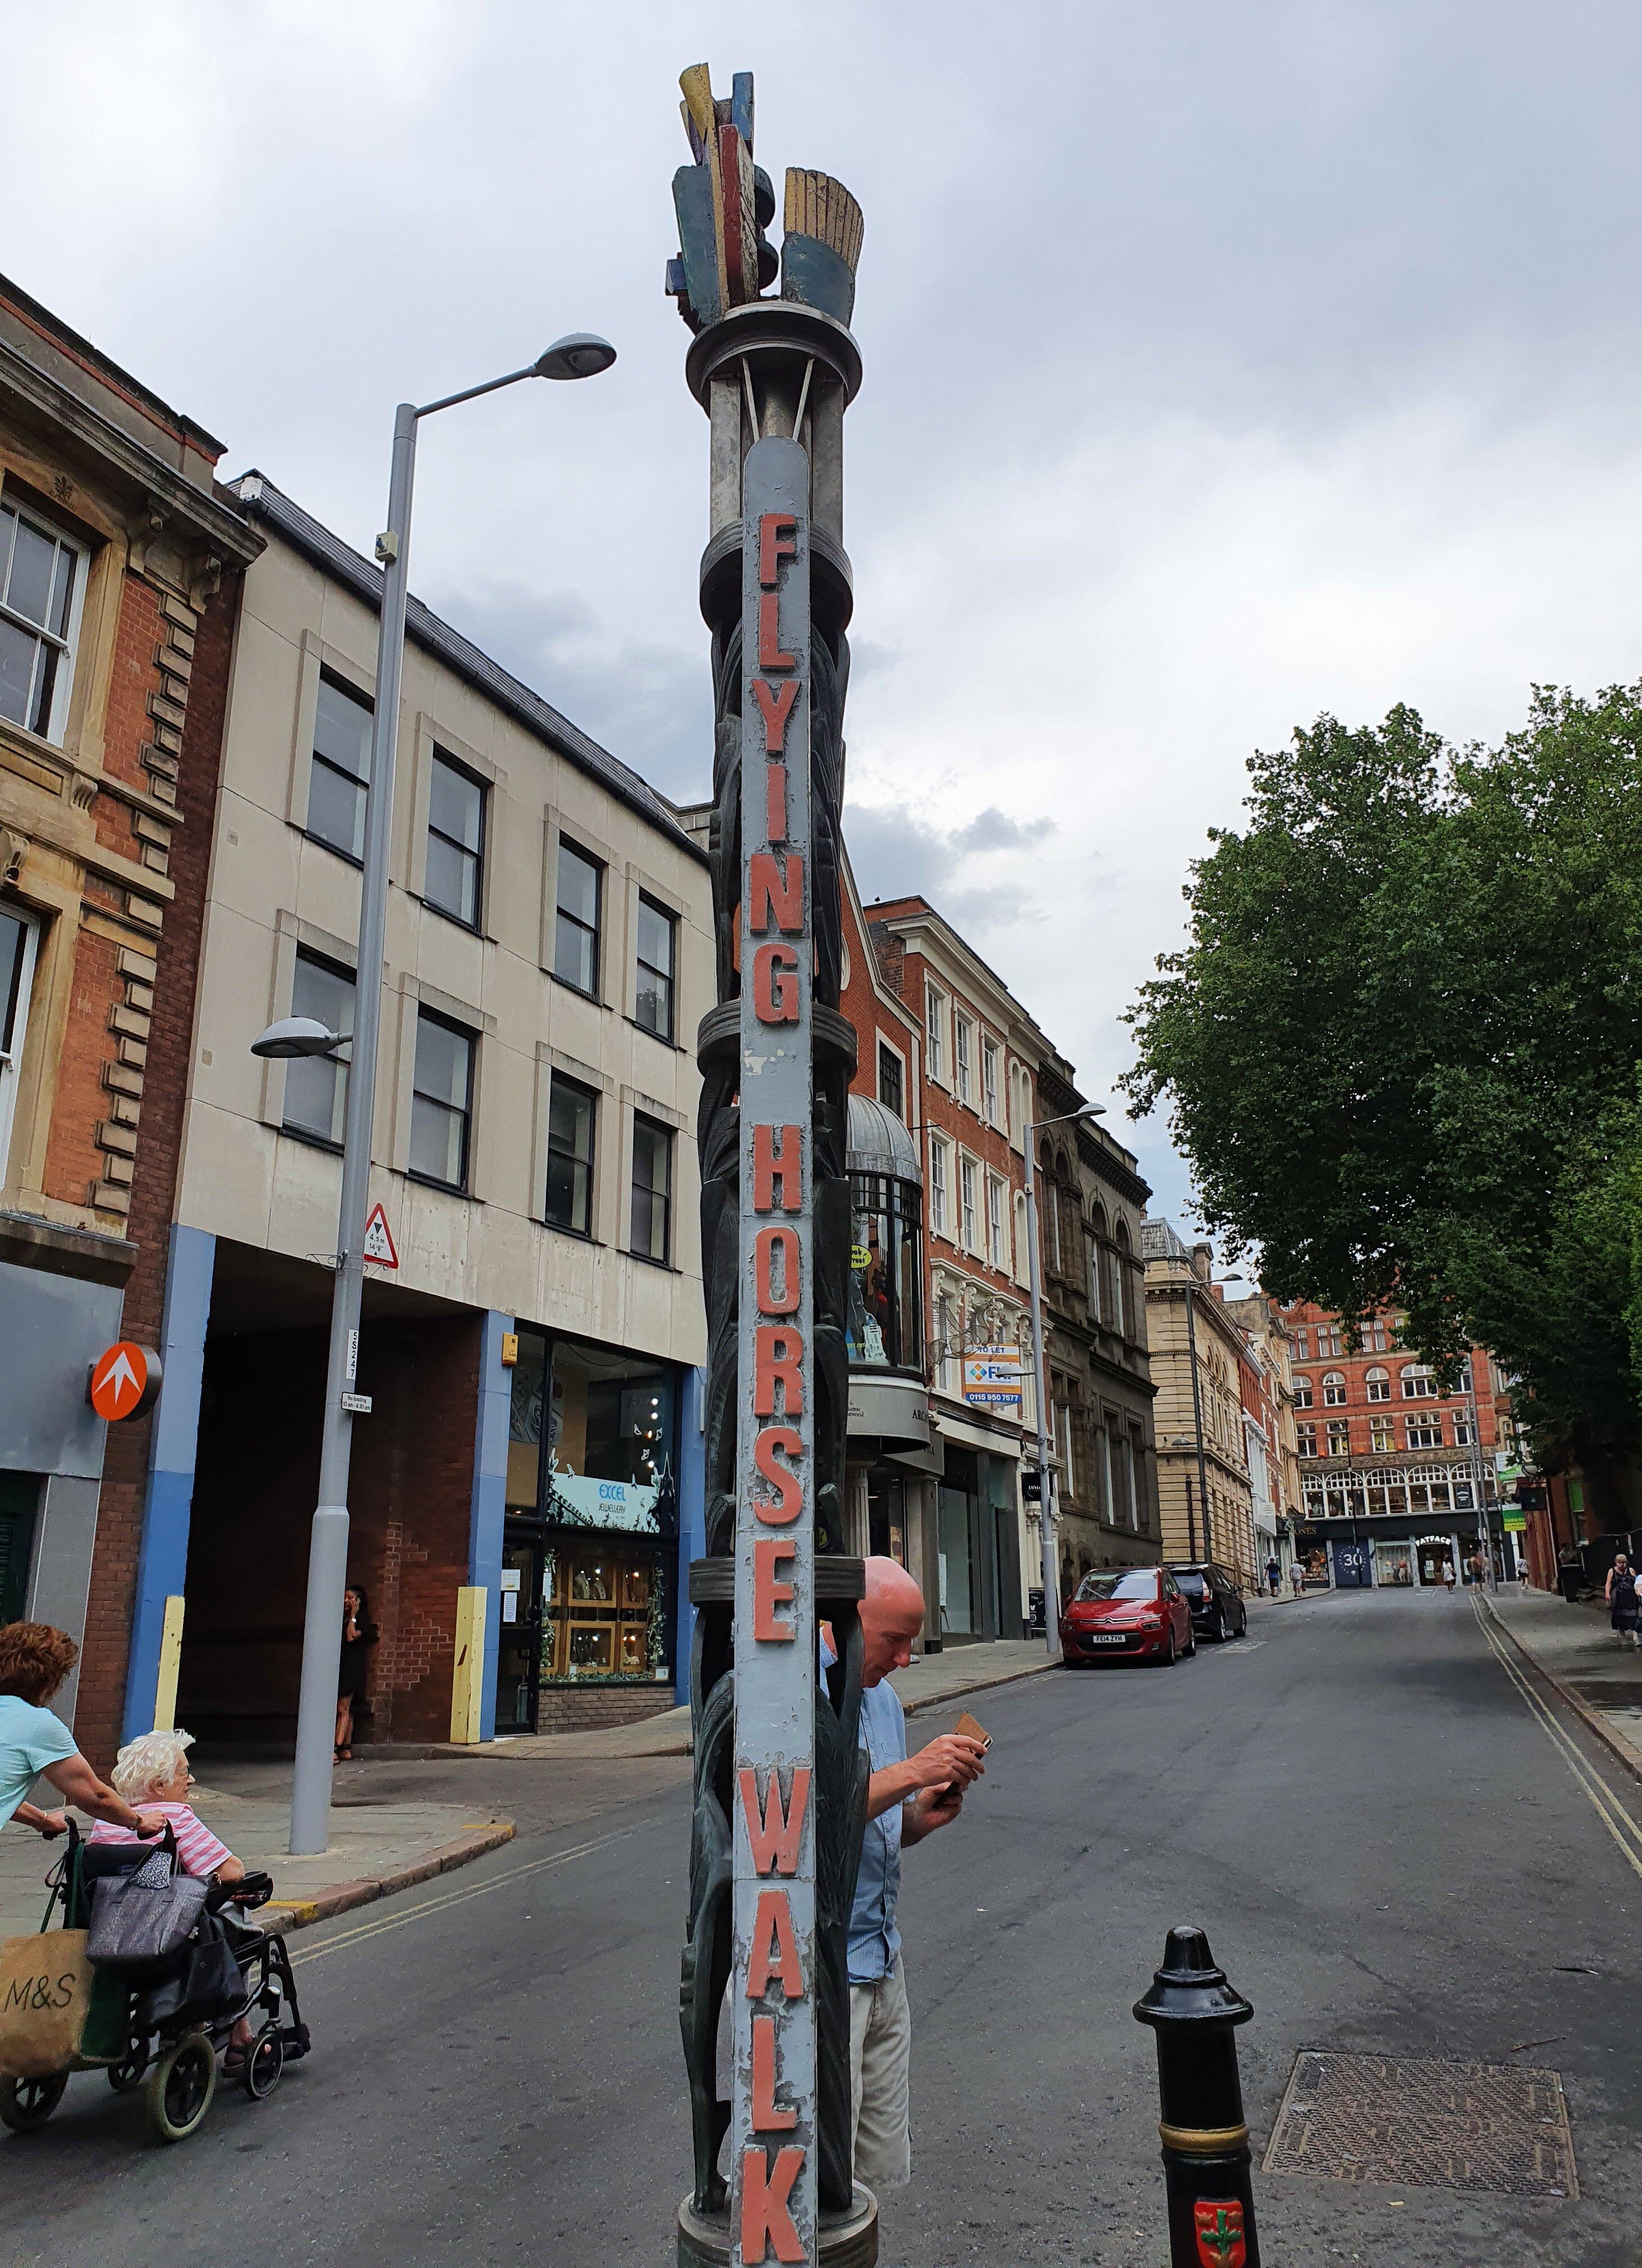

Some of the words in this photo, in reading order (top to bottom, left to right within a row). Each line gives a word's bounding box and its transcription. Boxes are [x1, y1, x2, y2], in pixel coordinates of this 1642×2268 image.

[750, 513, 804, 1025] FLYING
[754, 1124, 804, 1641] HORSE
[599, 1484, 626, 1501] EXCEL
[598, 1502, 626, 1514] JEWELLERY
[1294, 1527, 1316, 1535] ONES
[1415, 1535, 1451, 1547] FATFACE
[1343, 1553, 1363, 1566] 30
[4, 1972, 76, 2012] M&S
[738, 1767, 811, 2264] WALK
